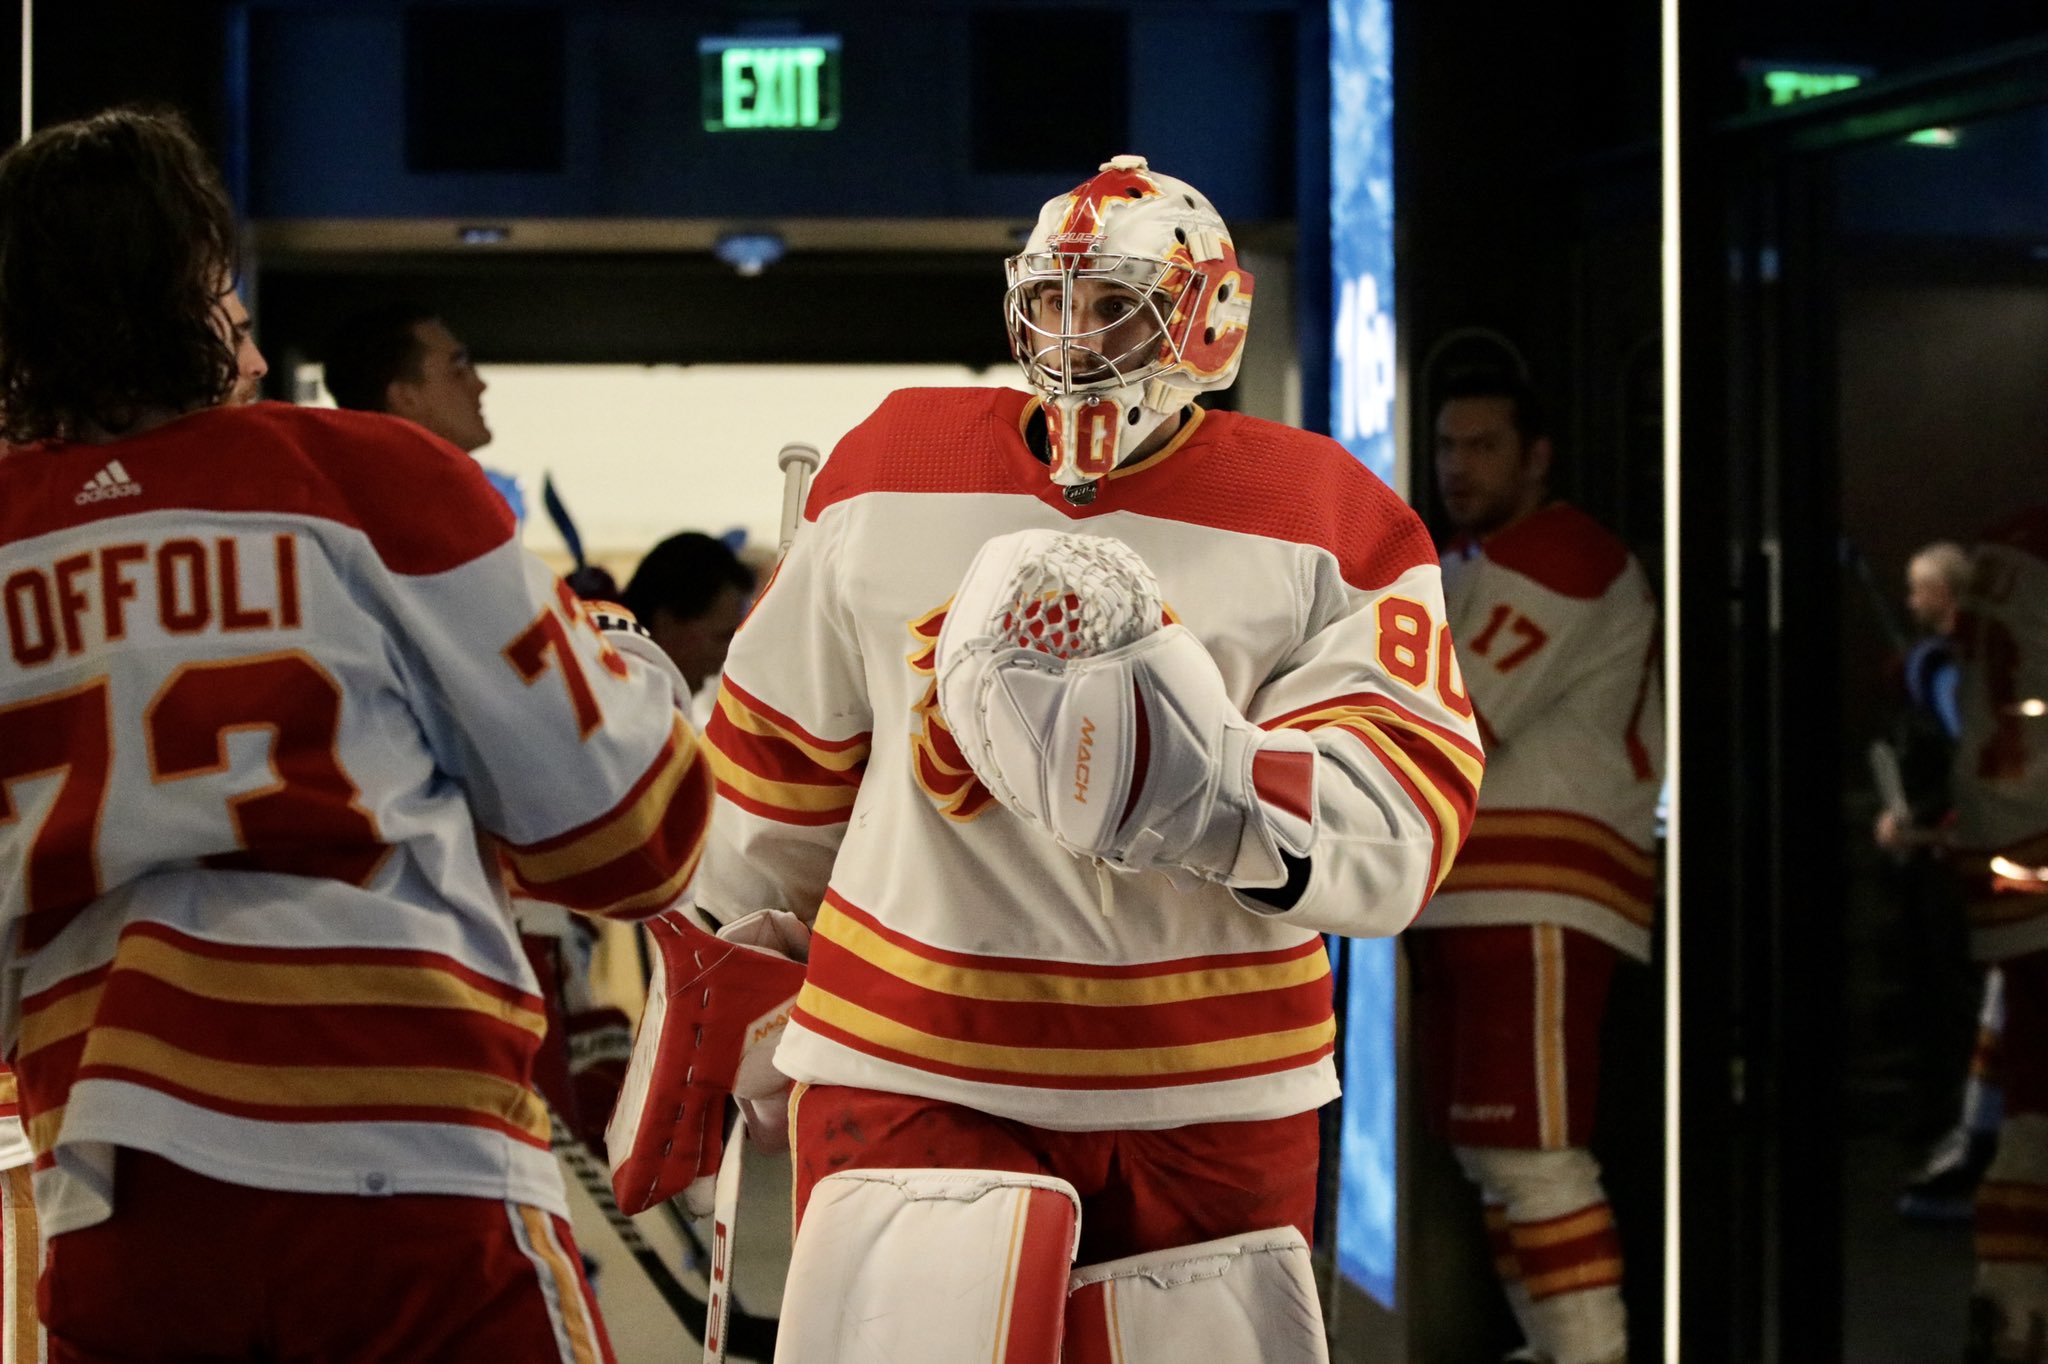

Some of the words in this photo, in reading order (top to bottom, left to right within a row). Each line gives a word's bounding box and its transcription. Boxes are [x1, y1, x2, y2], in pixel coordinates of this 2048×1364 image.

[722, 47, 826, 128] EXIT
[1041, 398, 1124, 478] 80
[75, 482, 142, 505] adidas
[3, 532, 303, 670] OFFOLI
[1469, 603, 1548, 675] 17
[1375, 594, 1473, 723] 80
[1074, 715, 1095, 804] MACH
[0, 648, 400, 957] 73
